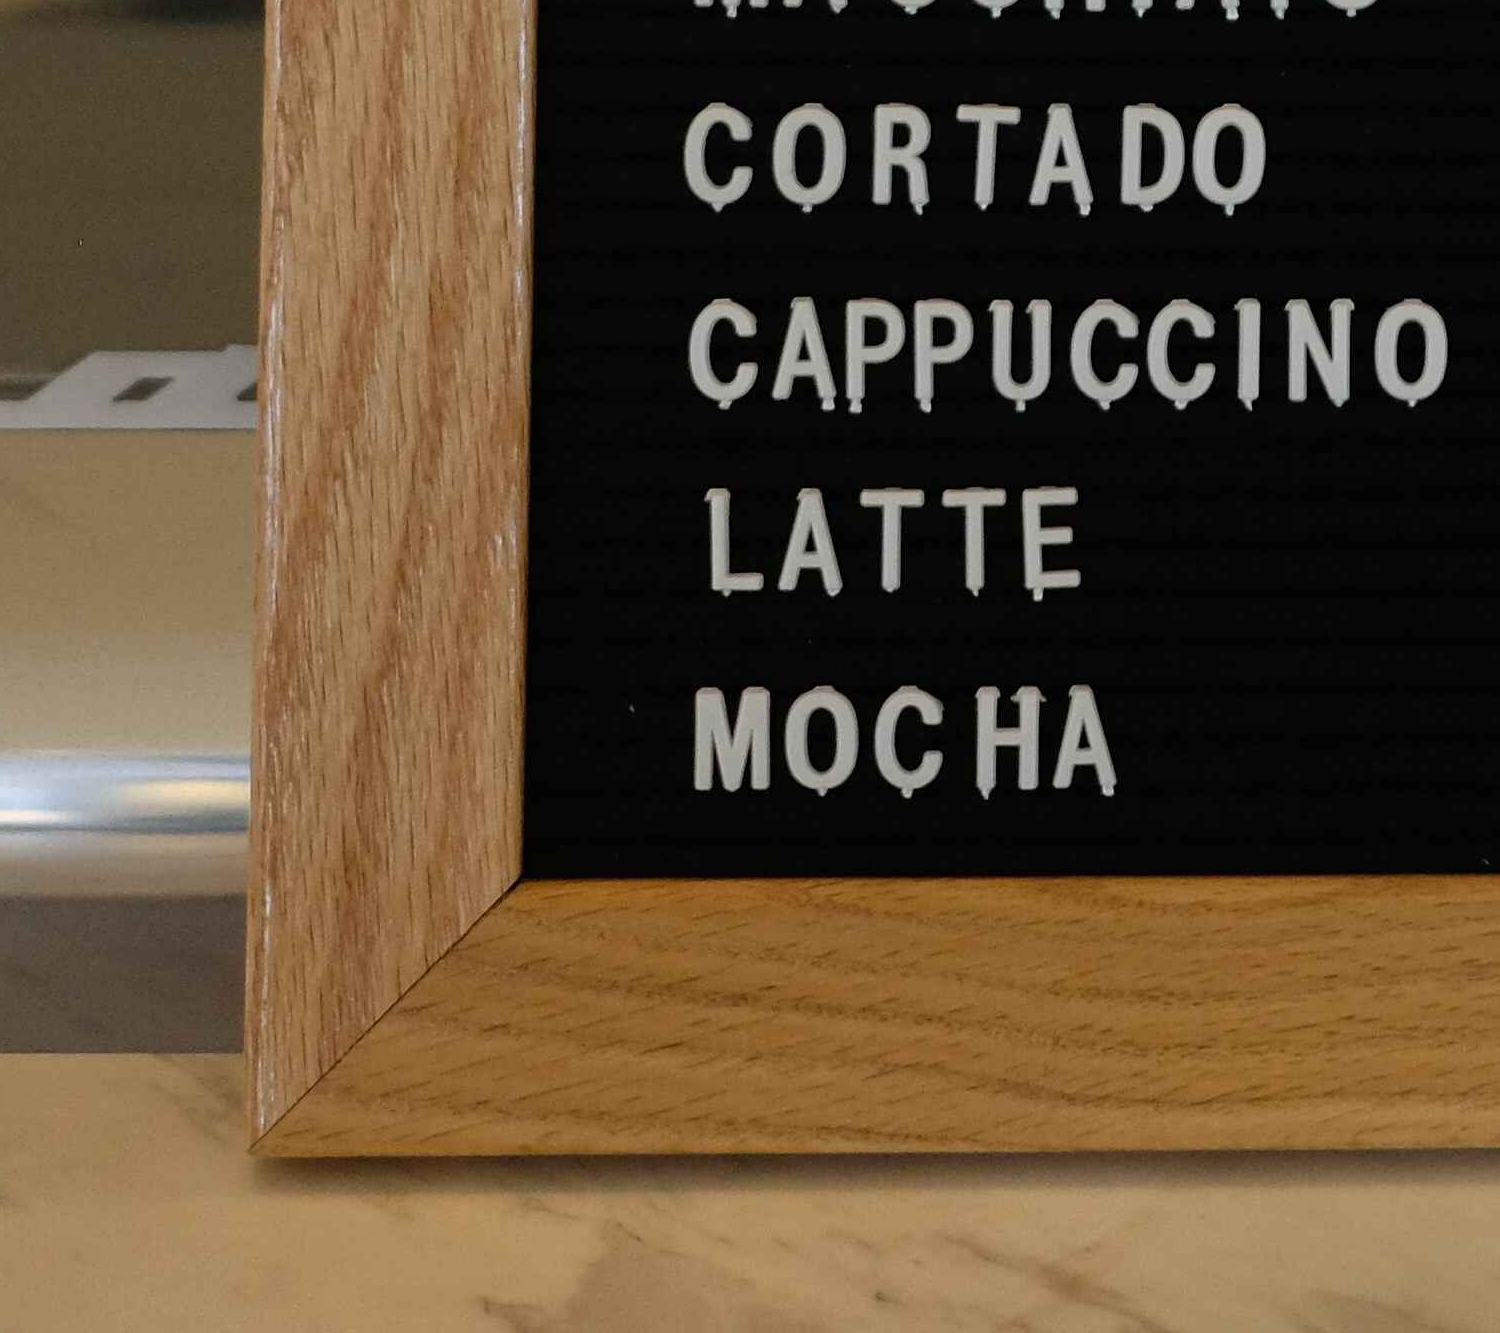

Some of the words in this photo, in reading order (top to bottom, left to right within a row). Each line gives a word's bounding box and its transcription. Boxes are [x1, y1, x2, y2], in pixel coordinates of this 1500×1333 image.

[684, 102, 1266, 216] CORTADO
[689, 296, 1448, 414] CAPPUCCINO
[704, 487, 1081, 602] LATTE
[694, 685, 1117, 800] MOCHA
